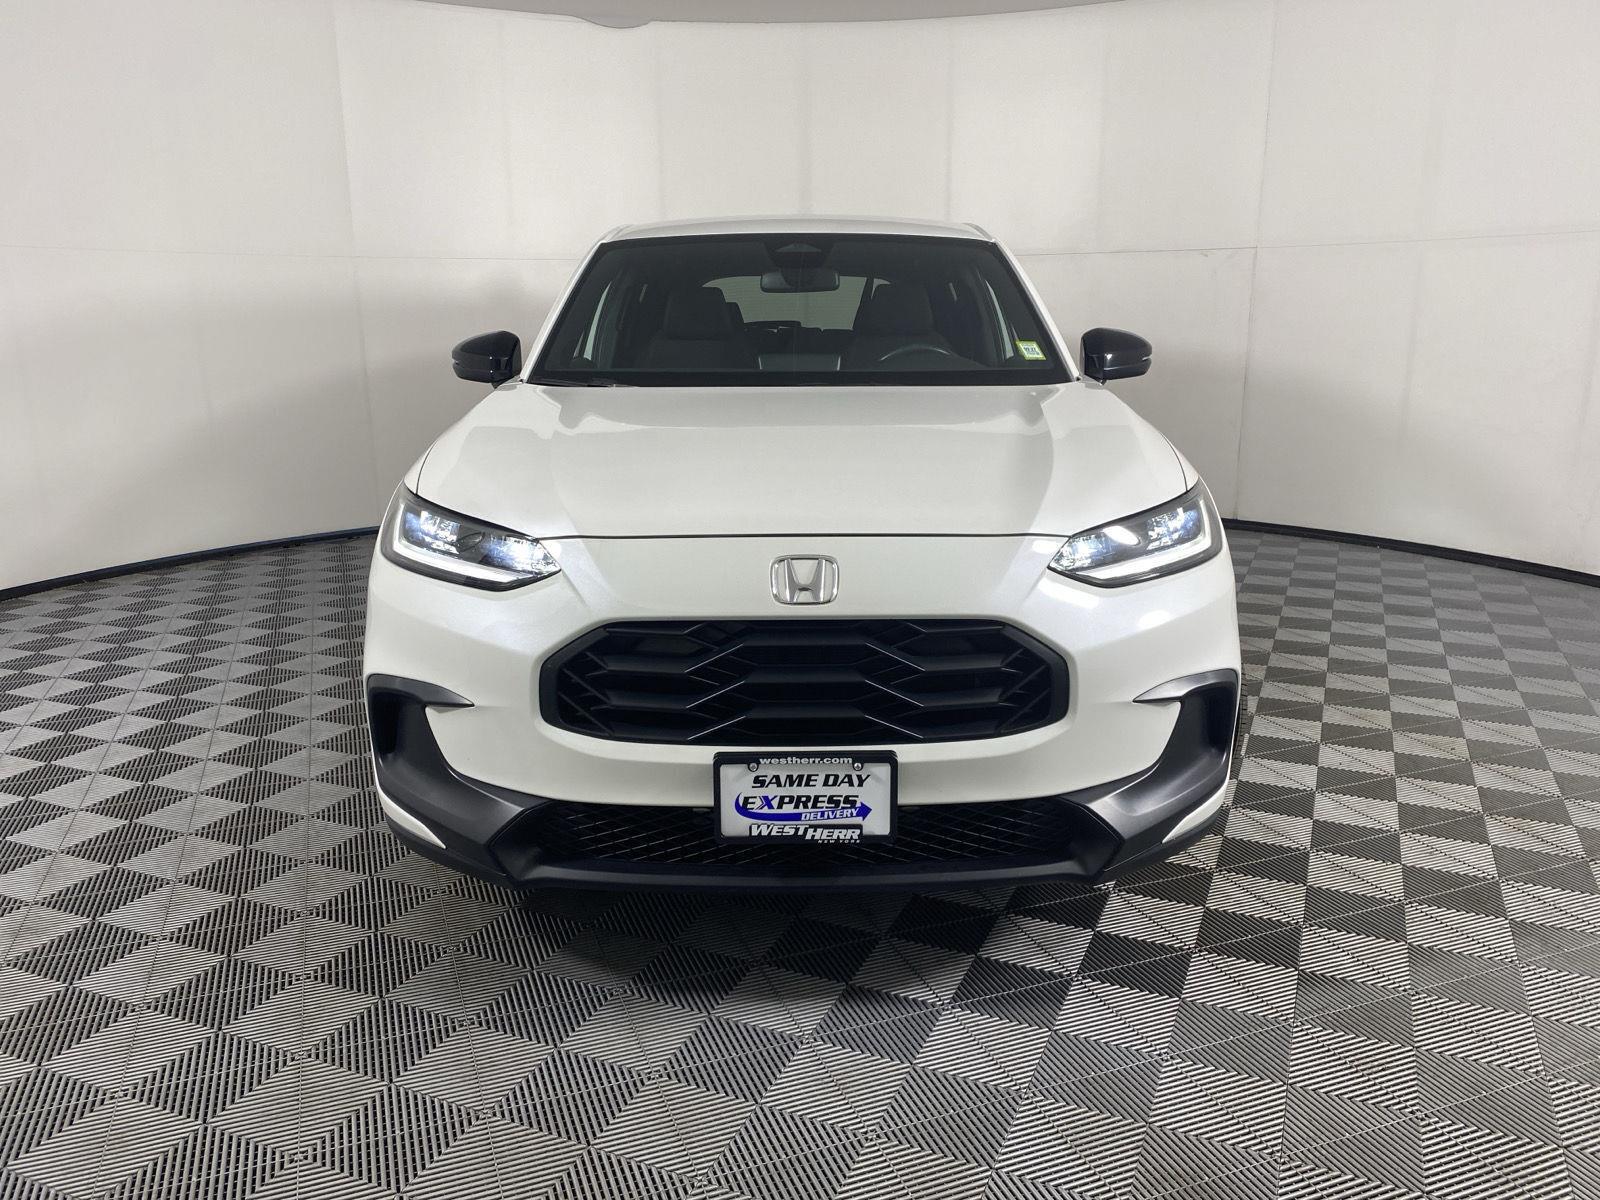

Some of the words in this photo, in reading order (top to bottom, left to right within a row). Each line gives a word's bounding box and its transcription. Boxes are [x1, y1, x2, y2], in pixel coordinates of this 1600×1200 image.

[759, 757, 853, 765] westherr.com
[752, 774, 819, 788] SAME
[822, 774, 871, 788] DAY
[742, 794, 860, 810] EXPRESS
[801, 808, 860, 821] DELIVERY
